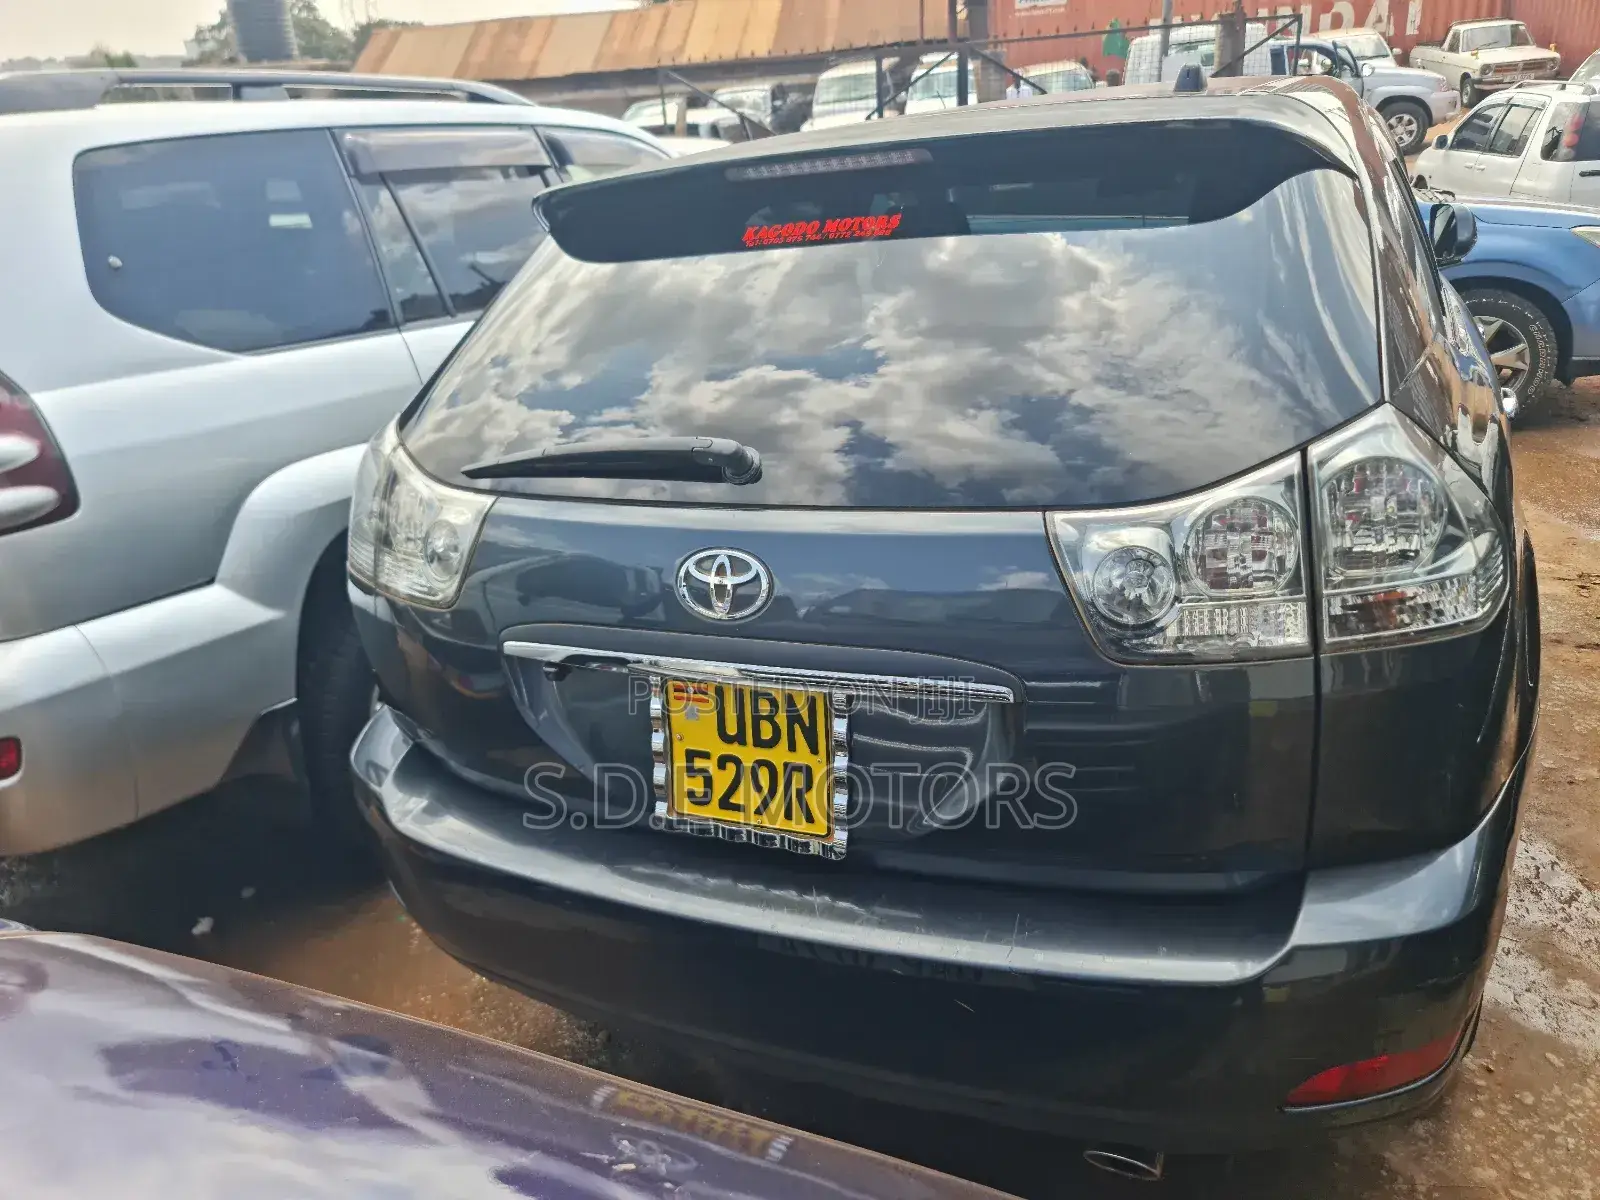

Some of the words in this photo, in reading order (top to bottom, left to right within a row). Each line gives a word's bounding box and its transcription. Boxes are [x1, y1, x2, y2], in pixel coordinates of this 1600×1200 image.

[823, 213, 902, 233] MOTORS
[714, 685, 820, 756] UBN
[684, 748, 816, 825] 529R
